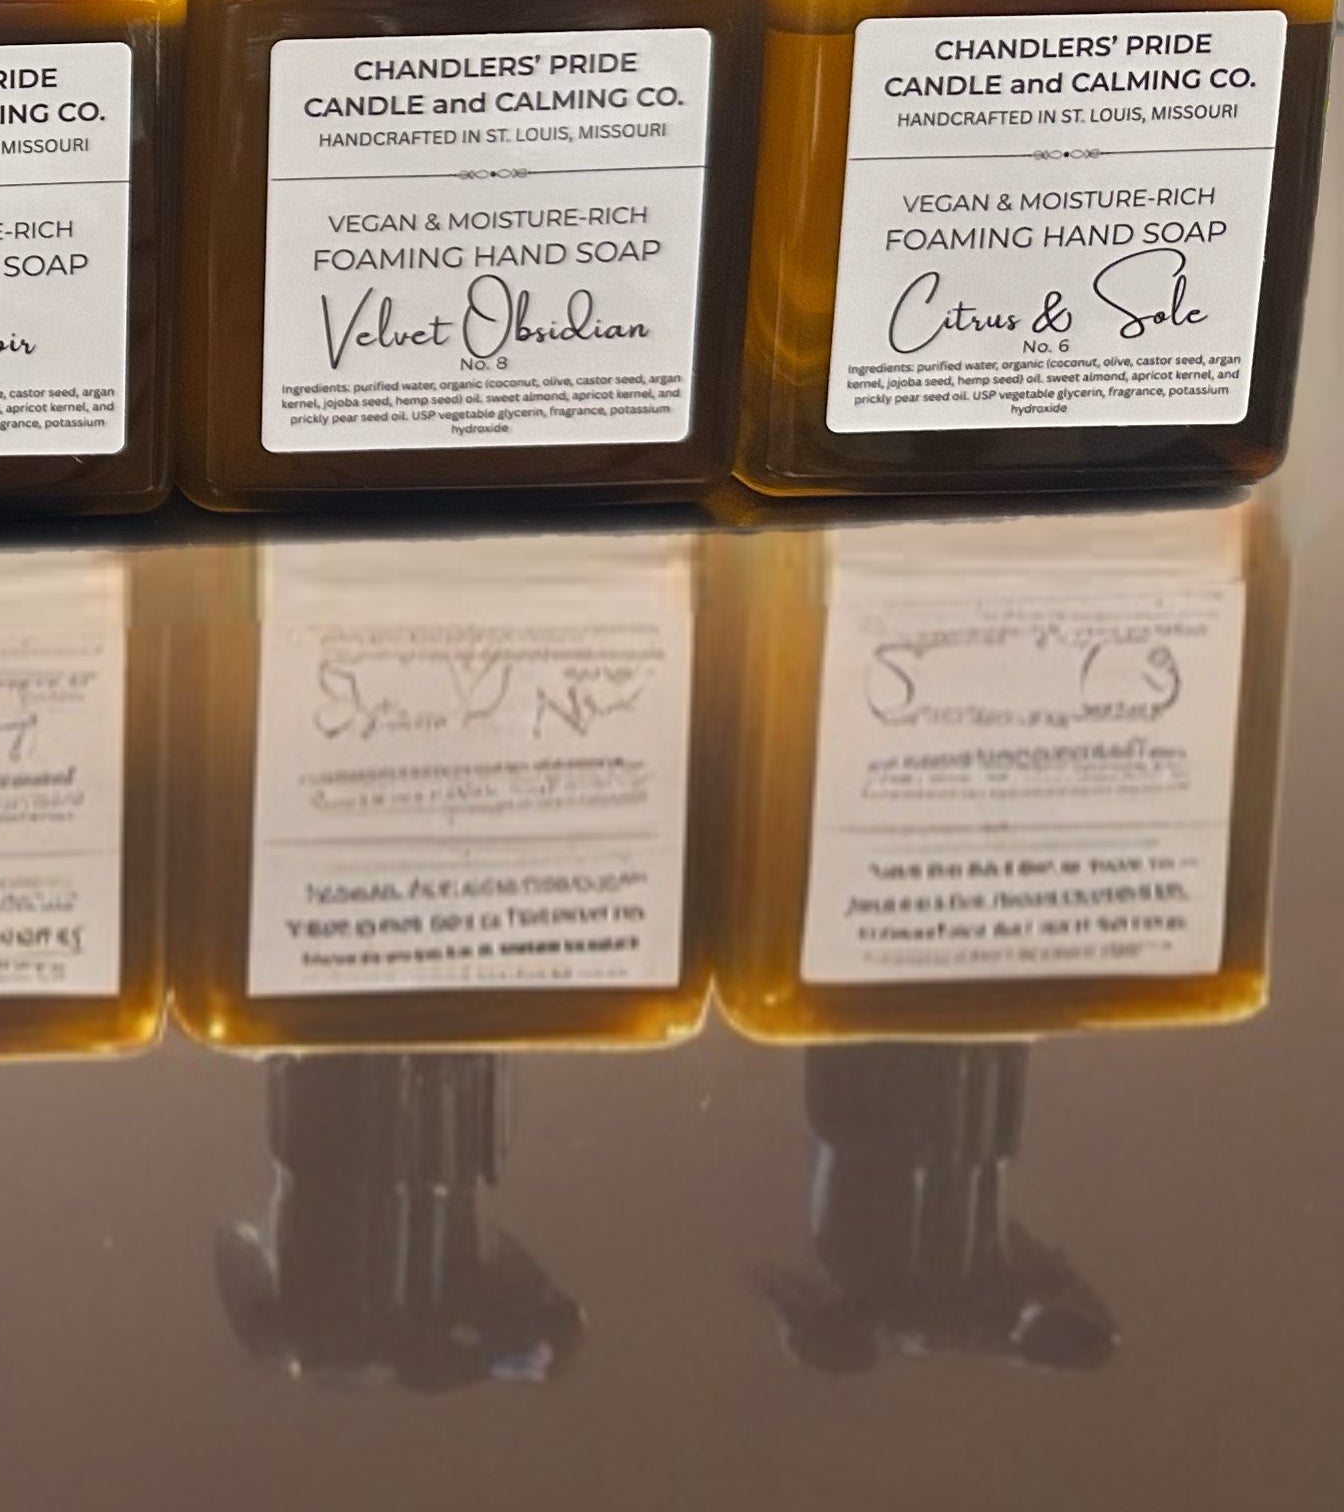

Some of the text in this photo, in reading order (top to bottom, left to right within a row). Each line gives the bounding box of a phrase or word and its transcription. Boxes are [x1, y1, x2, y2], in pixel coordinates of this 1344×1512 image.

[934, 32, 1213, 62] CHANDLERS' PRIDE
[353, 51, 639, 82] CHANDLERS' PRIDE
[884, 67, 1257, 98] CANDLE and CALMING CO.
[57, 101, 107, 123] CO.
[303, 86, 686, 118] CANDLE and CALMING CO.
[897, 103, 1239, 128] HANDCRAFTED IN ST. LOUIS, MISSOURI
[902, 186, 1216, 214] VEGAN & MOISTURE-RICH
[327, 205, 649, 234] VEGAN & MOISTURE-RICH
[885, 220, 1228, 252] FOAMING HAND SOAP
[3, 253, 90, 279] SOAP
[313, 239, 664, 272] FOAMING HAND SOAP
[888, 247, 1209, 355] Citrus & Sole
[320, 273, 651, 371] Velvet Obsidian
[1022, 338, 1071, 354] No. 6
[459, 355, 510, 372] No. 8
[450, 422, 513, 437] hydroxide
